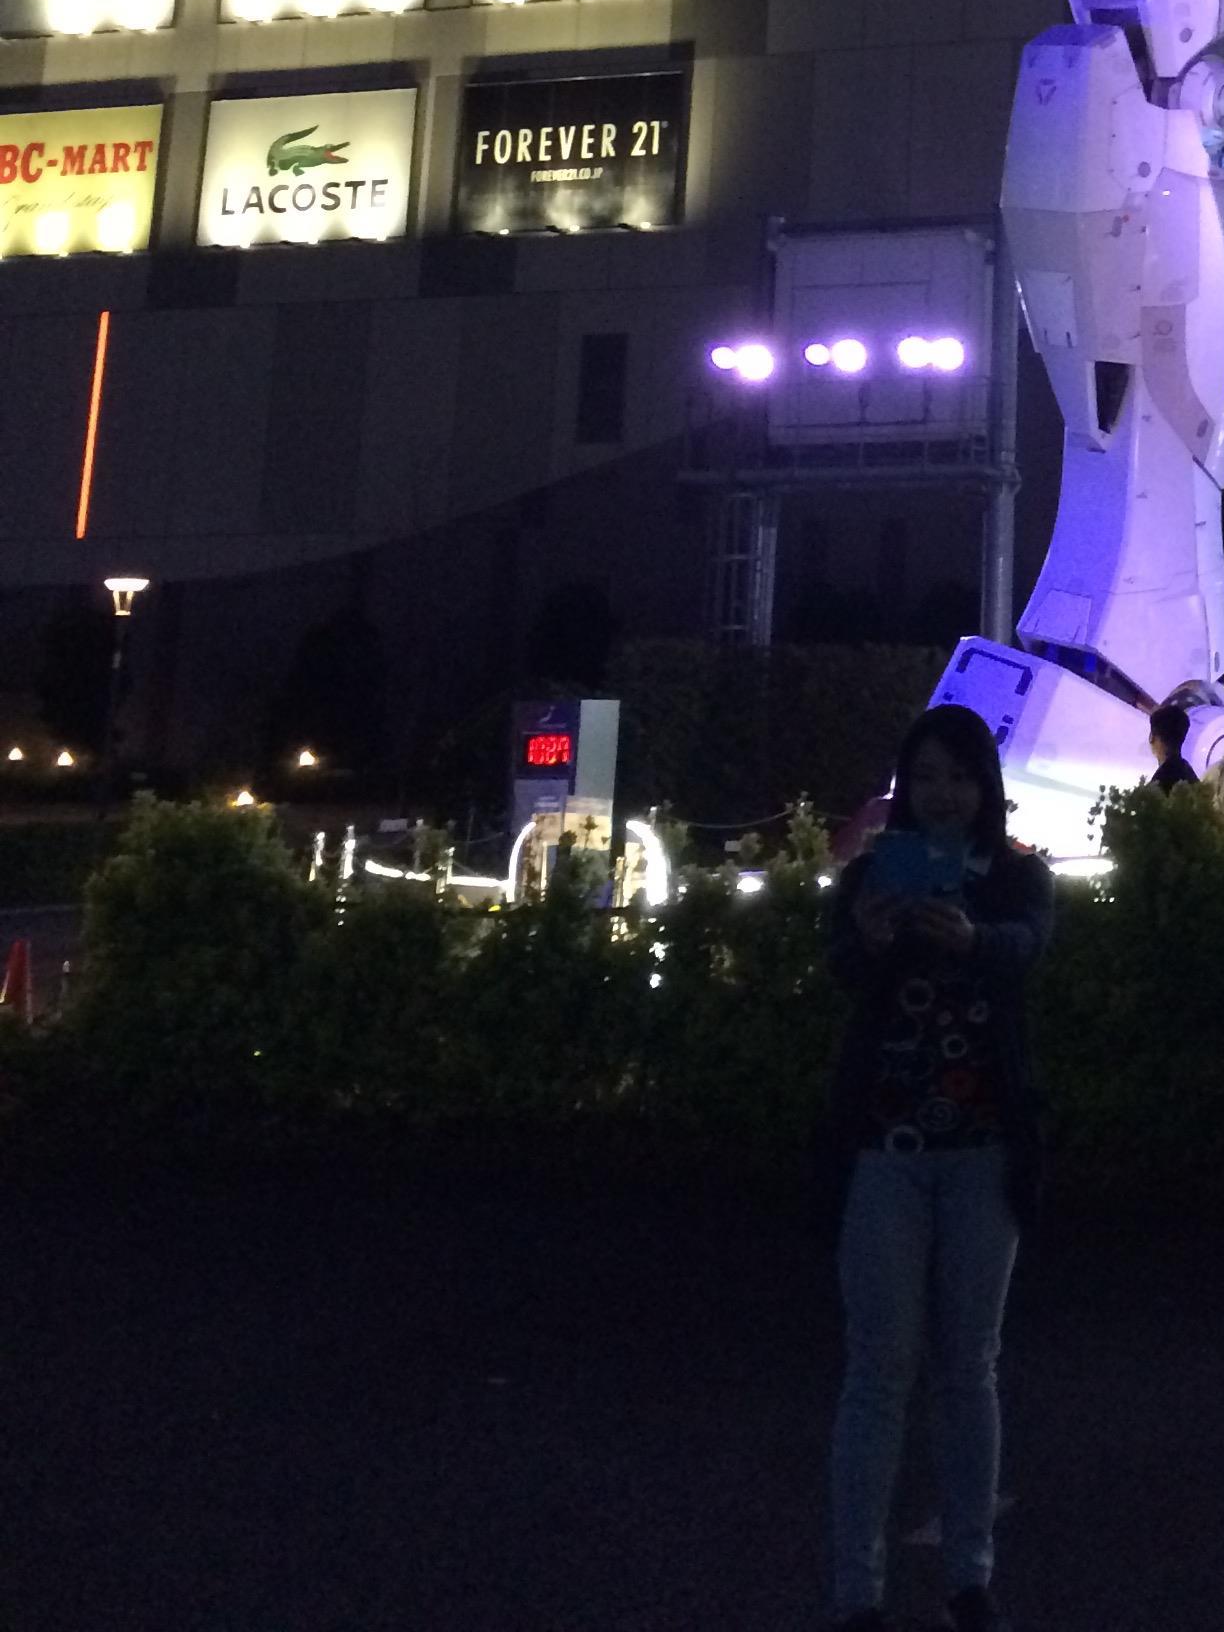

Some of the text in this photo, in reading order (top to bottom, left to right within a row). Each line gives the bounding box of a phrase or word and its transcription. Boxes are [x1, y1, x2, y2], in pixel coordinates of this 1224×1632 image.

[475, 120, 661, 166] FOREVER 21
[221, 179, 389, 216] LACOSTE
